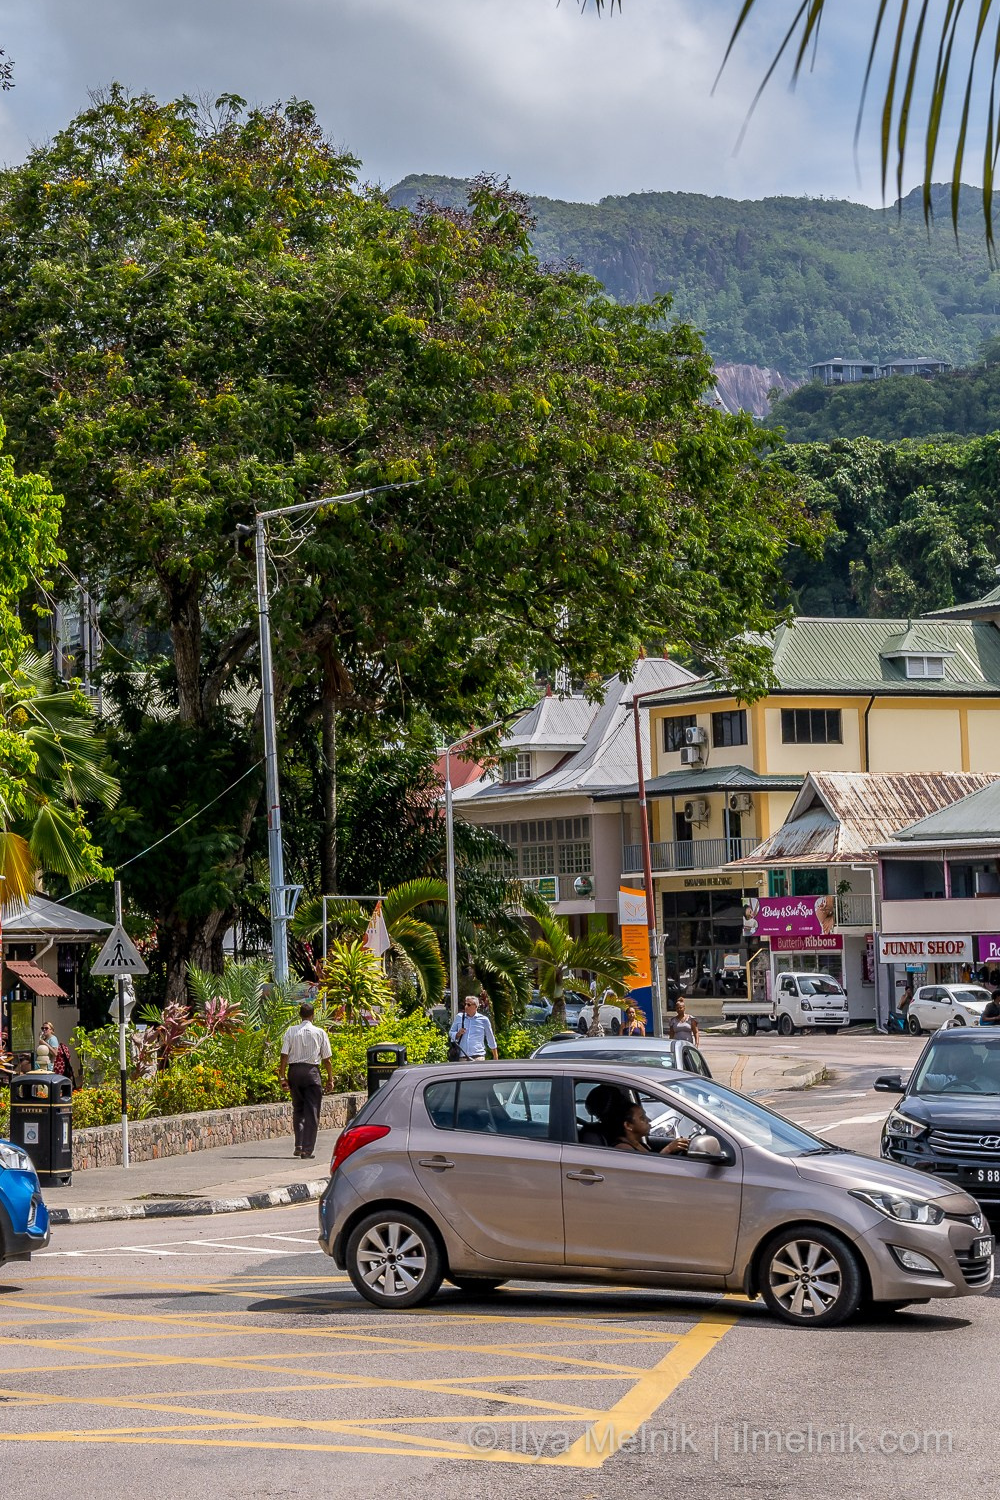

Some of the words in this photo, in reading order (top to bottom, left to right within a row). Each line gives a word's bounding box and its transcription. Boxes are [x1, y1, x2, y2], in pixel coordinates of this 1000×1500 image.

[762, 905, 780, 919] Body
[785, 905, 800, 917] Sole
[800, 904, 813, 918] Spa
[882, 941, 924, 955] JUNNI
[927, 940, 964, 955] SHOP
[978, 1169, 984, 1181] S
